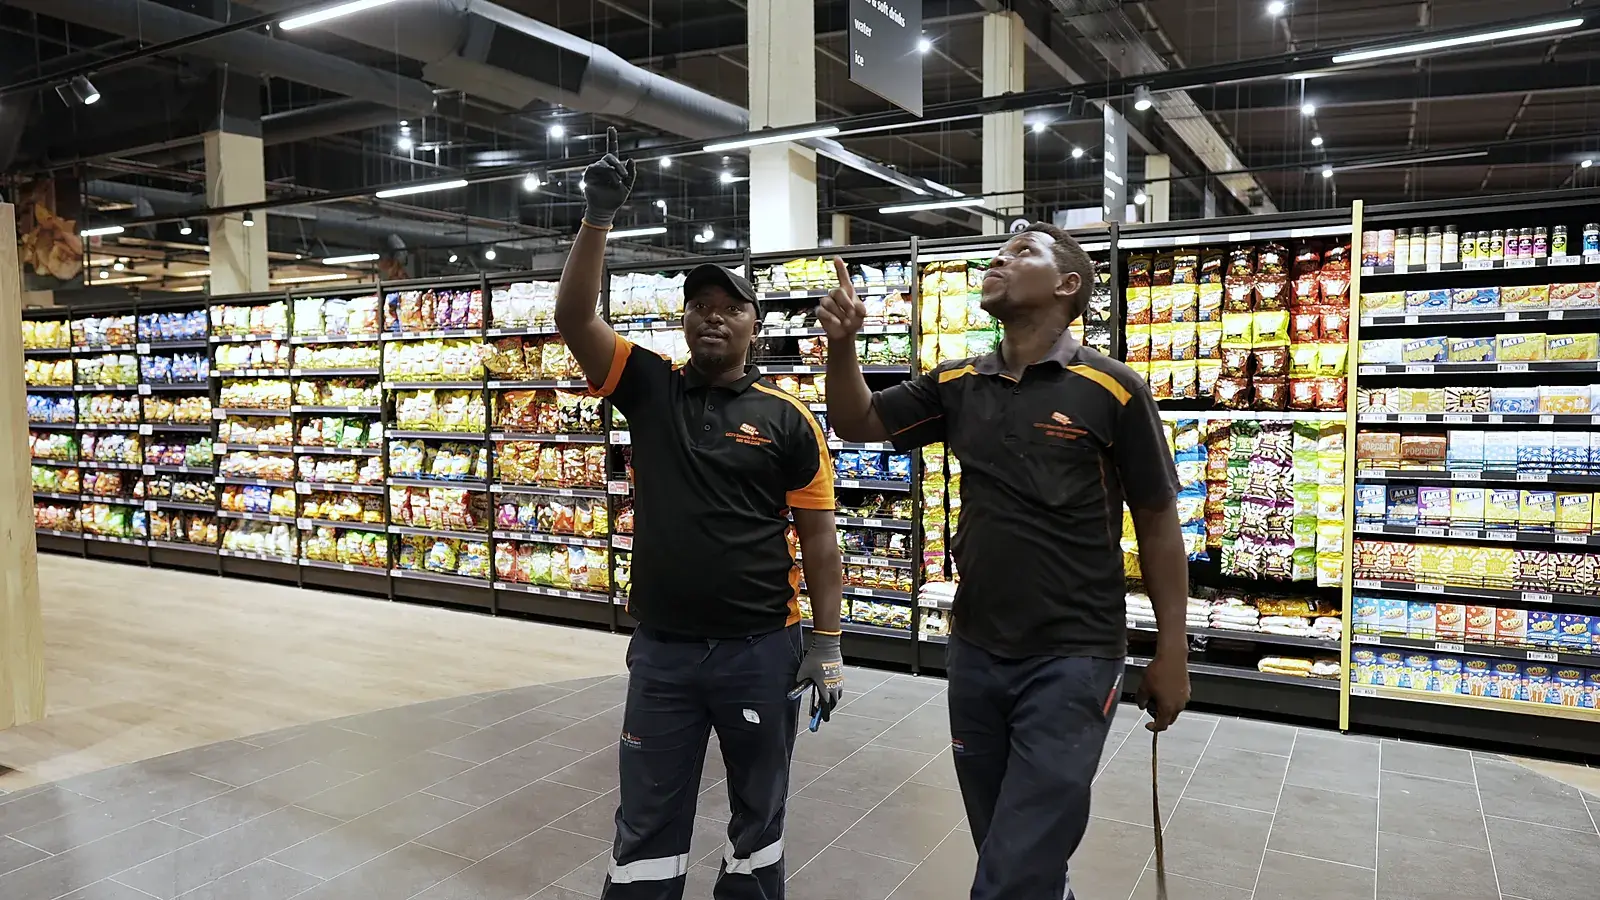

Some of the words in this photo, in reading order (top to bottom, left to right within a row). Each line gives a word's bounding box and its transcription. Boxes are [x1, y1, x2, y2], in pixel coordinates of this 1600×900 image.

[877, 1, 889, 16] soft
[889, 6, 906, 28] drinks
[854, 19, 873, 37] water
[855, 50, 865, 67] ice
[1361, 441, 1394, 452] POPCORN
[1405, 445, 1440, 456] POPCORN
